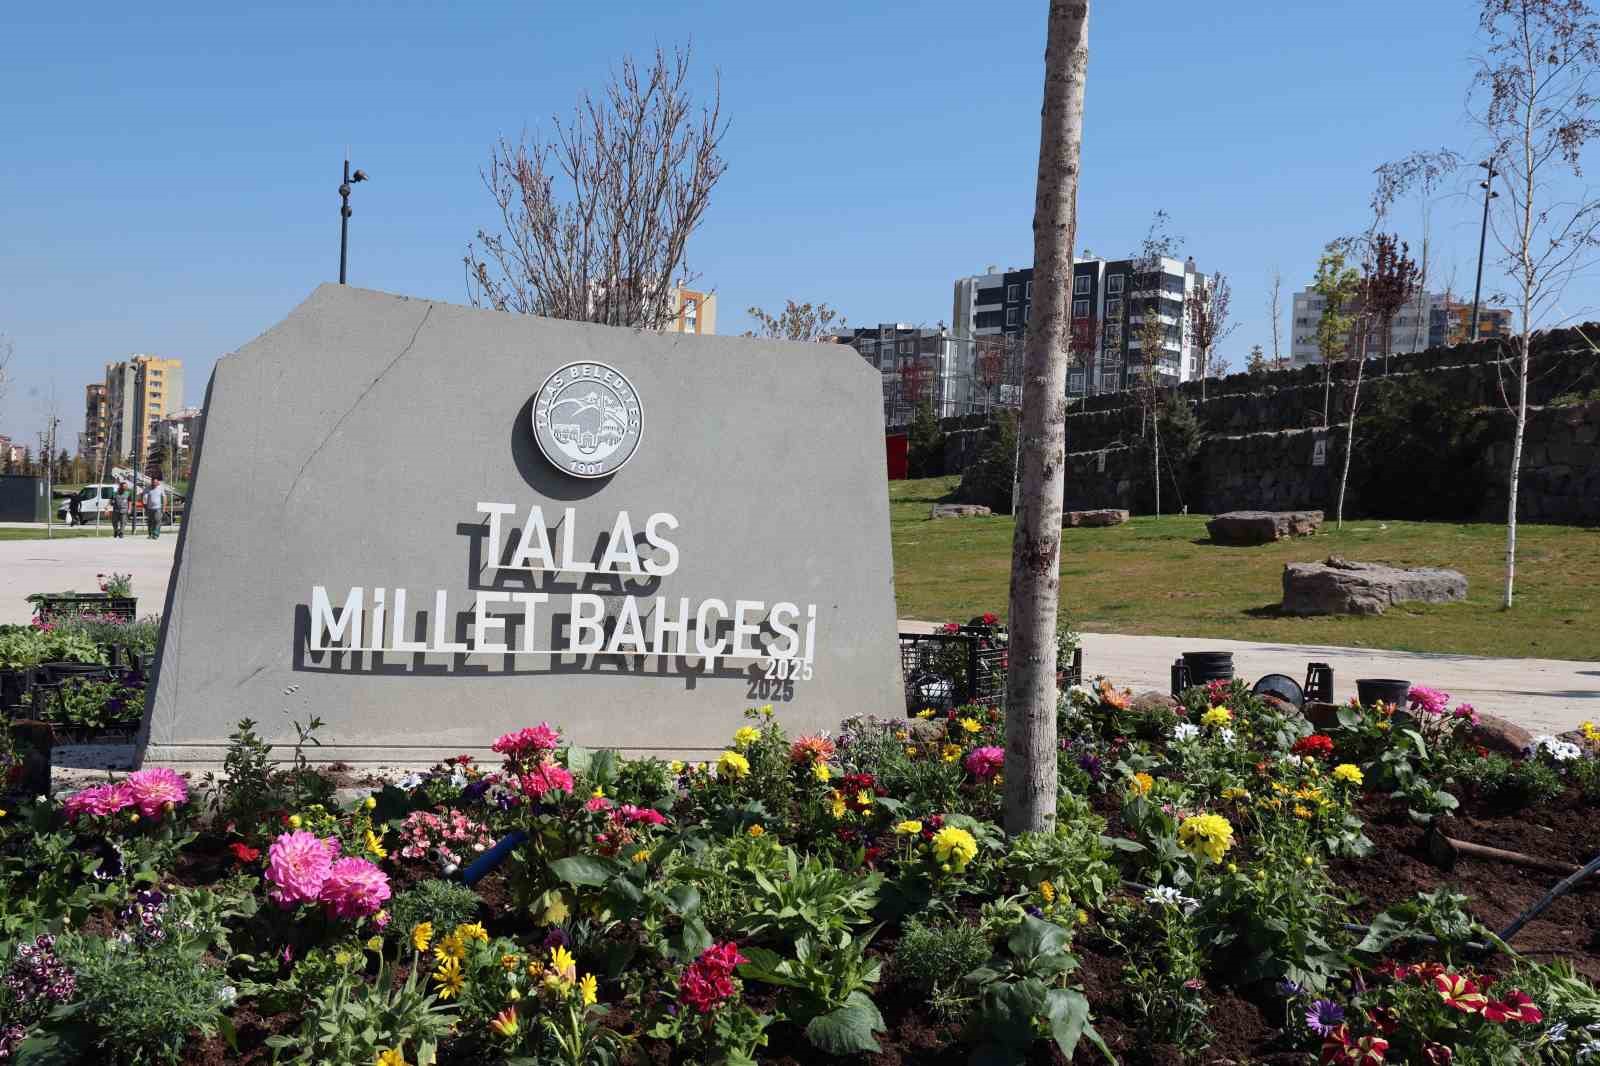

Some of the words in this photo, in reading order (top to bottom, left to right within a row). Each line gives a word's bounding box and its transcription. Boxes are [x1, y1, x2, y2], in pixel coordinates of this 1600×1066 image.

[536, 375, 564, 429] TALAS
[569, 461, 605, 474] 1907
[477, 502, 680, 576] TALAS
[764, 659, 813, 681] 2025
